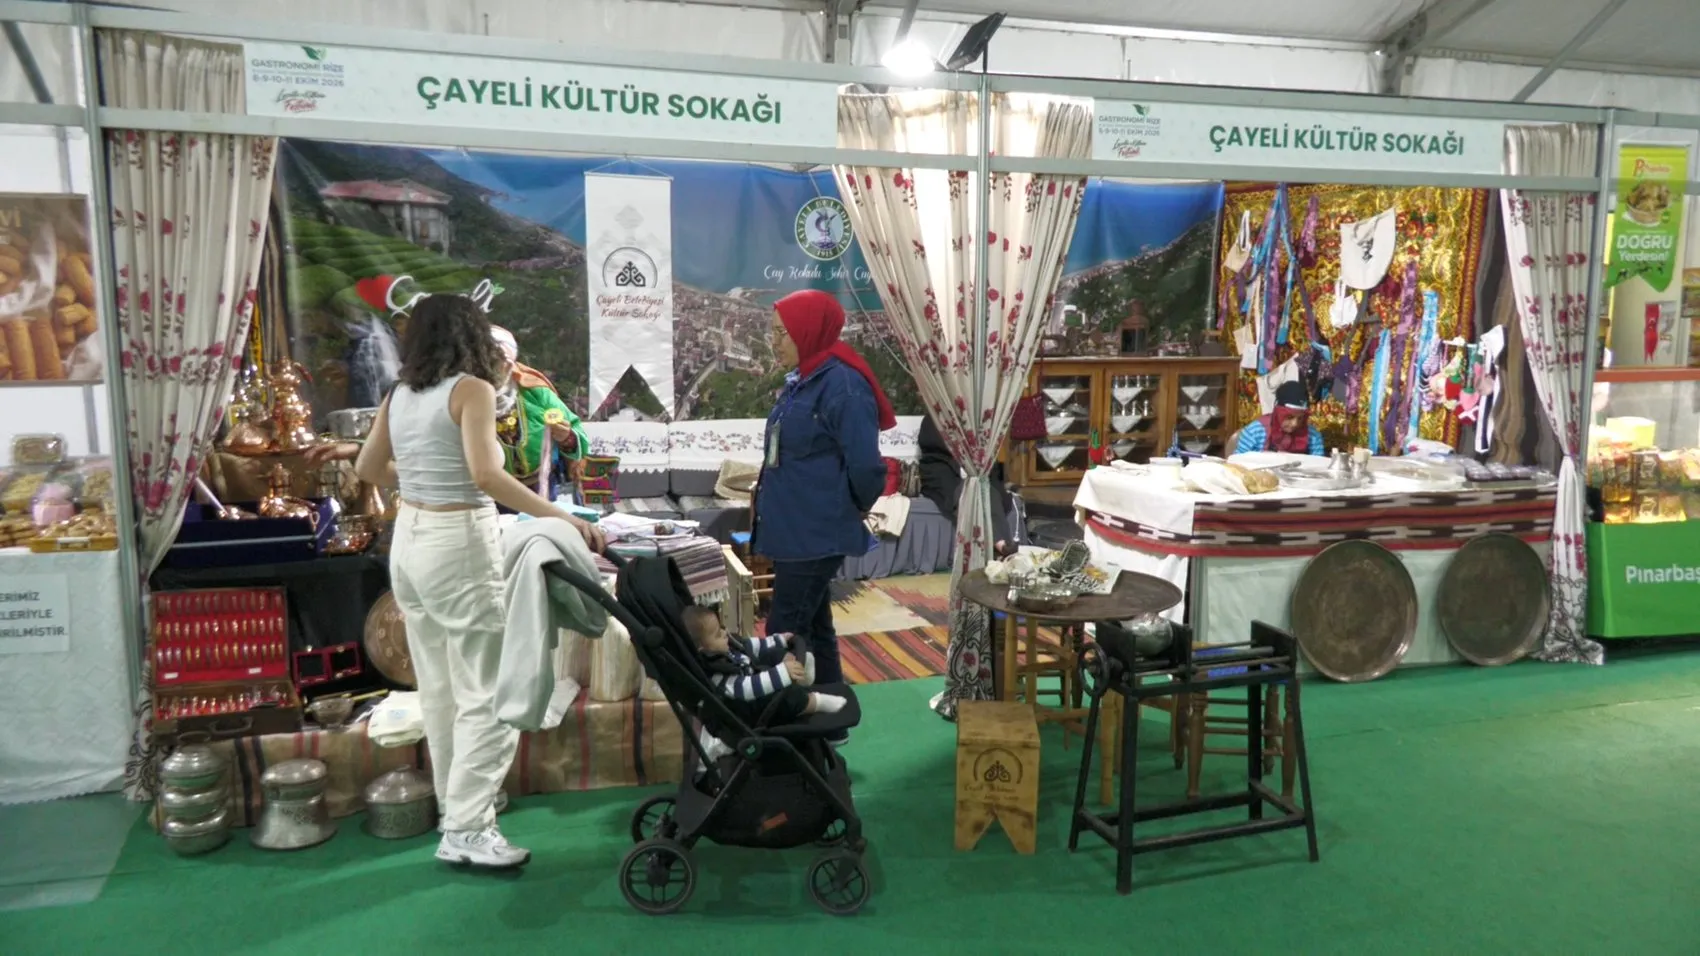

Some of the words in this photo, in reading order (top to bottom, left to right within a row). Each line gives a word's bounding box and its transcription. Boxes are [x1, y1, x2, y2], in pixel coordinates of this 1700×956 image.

[417, 76, 532, 110] ÇAYELİ
[542, 80, 660, 117] KÜLTÜR
[667, 93, 782, 124] SOKAĞI
[1209, 124, 1288, 152] ÇAYELİ
[1294, 125, 1377, 152] KÜLTÜR
[1382, 130, 1464, 155] SOKAĞI
